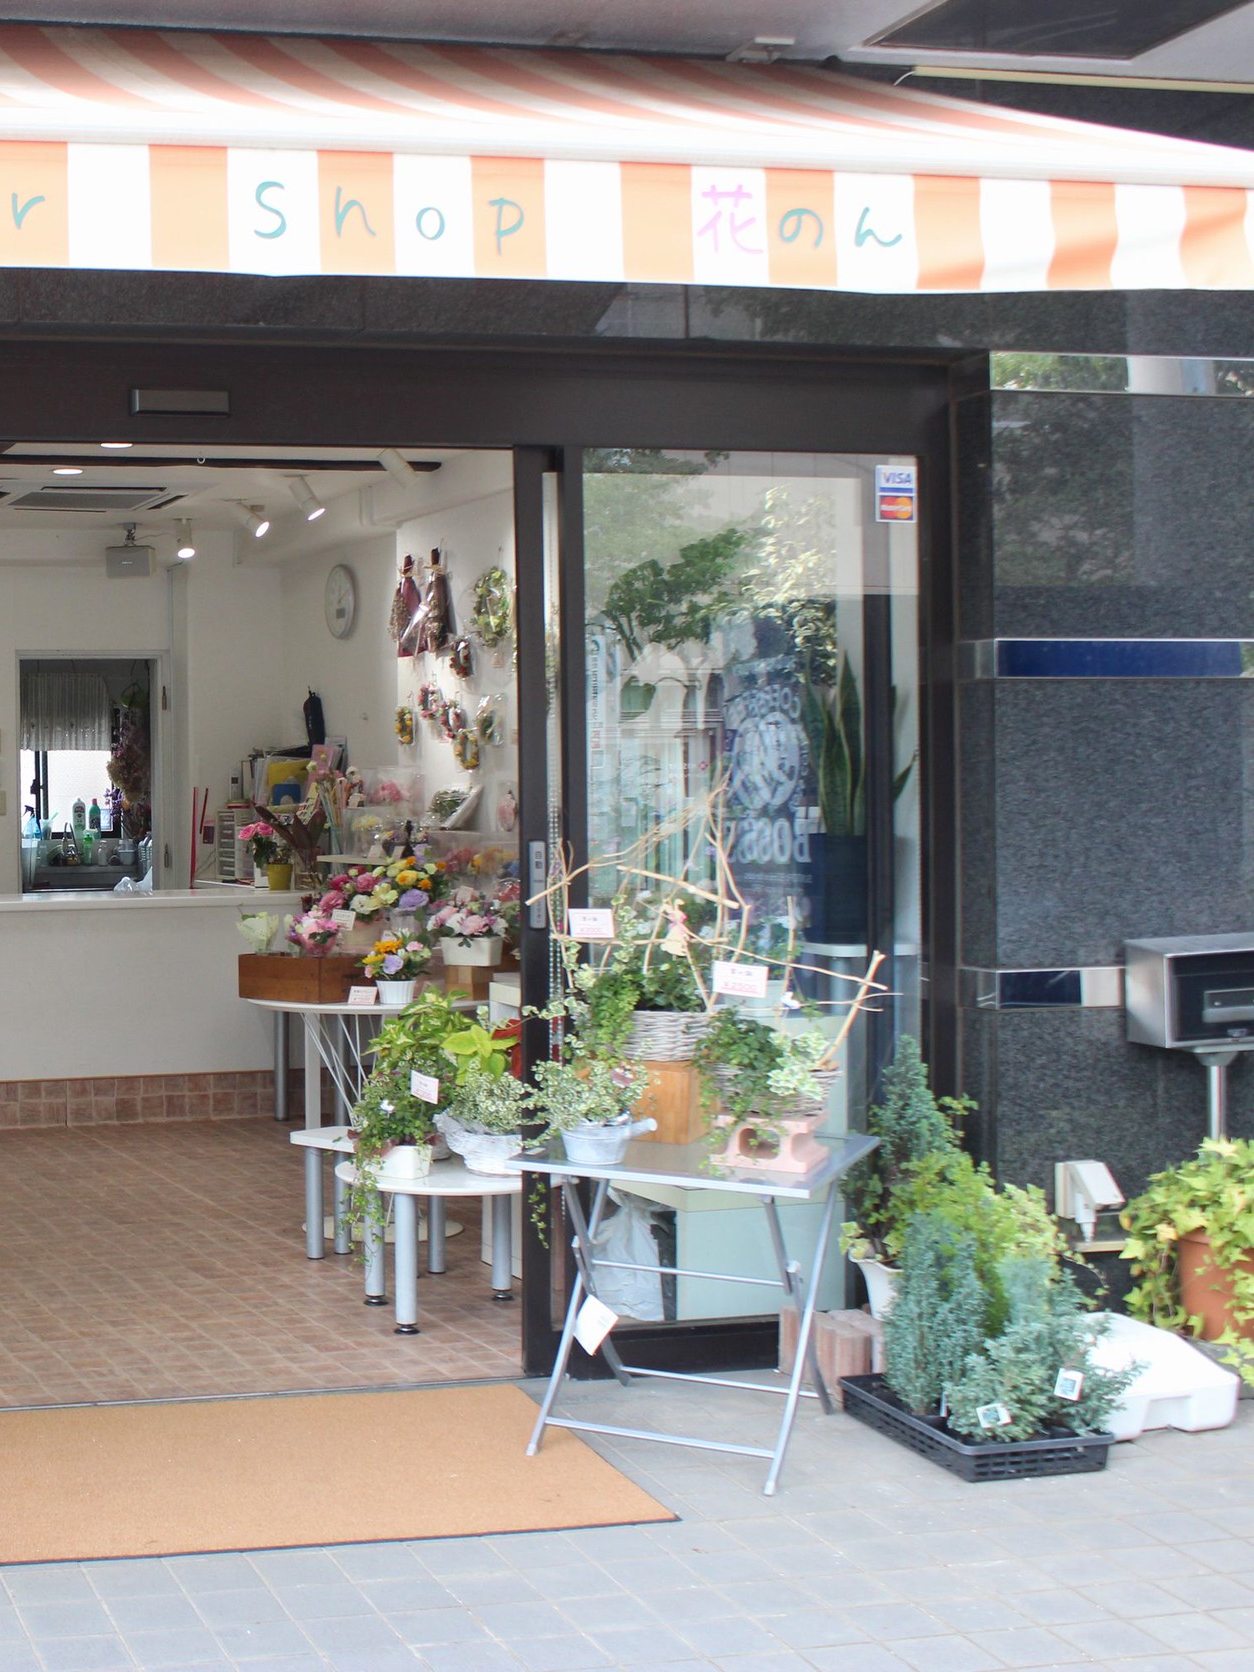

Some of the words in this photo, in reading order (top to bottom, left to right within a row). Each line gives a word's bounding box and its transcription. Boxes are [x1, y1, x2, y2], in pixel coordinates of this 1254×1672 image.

[252, 179, 525, 256] Shop
[696, 183, 904, 255] 花のん
[881, 471, 913, 484] VISA
